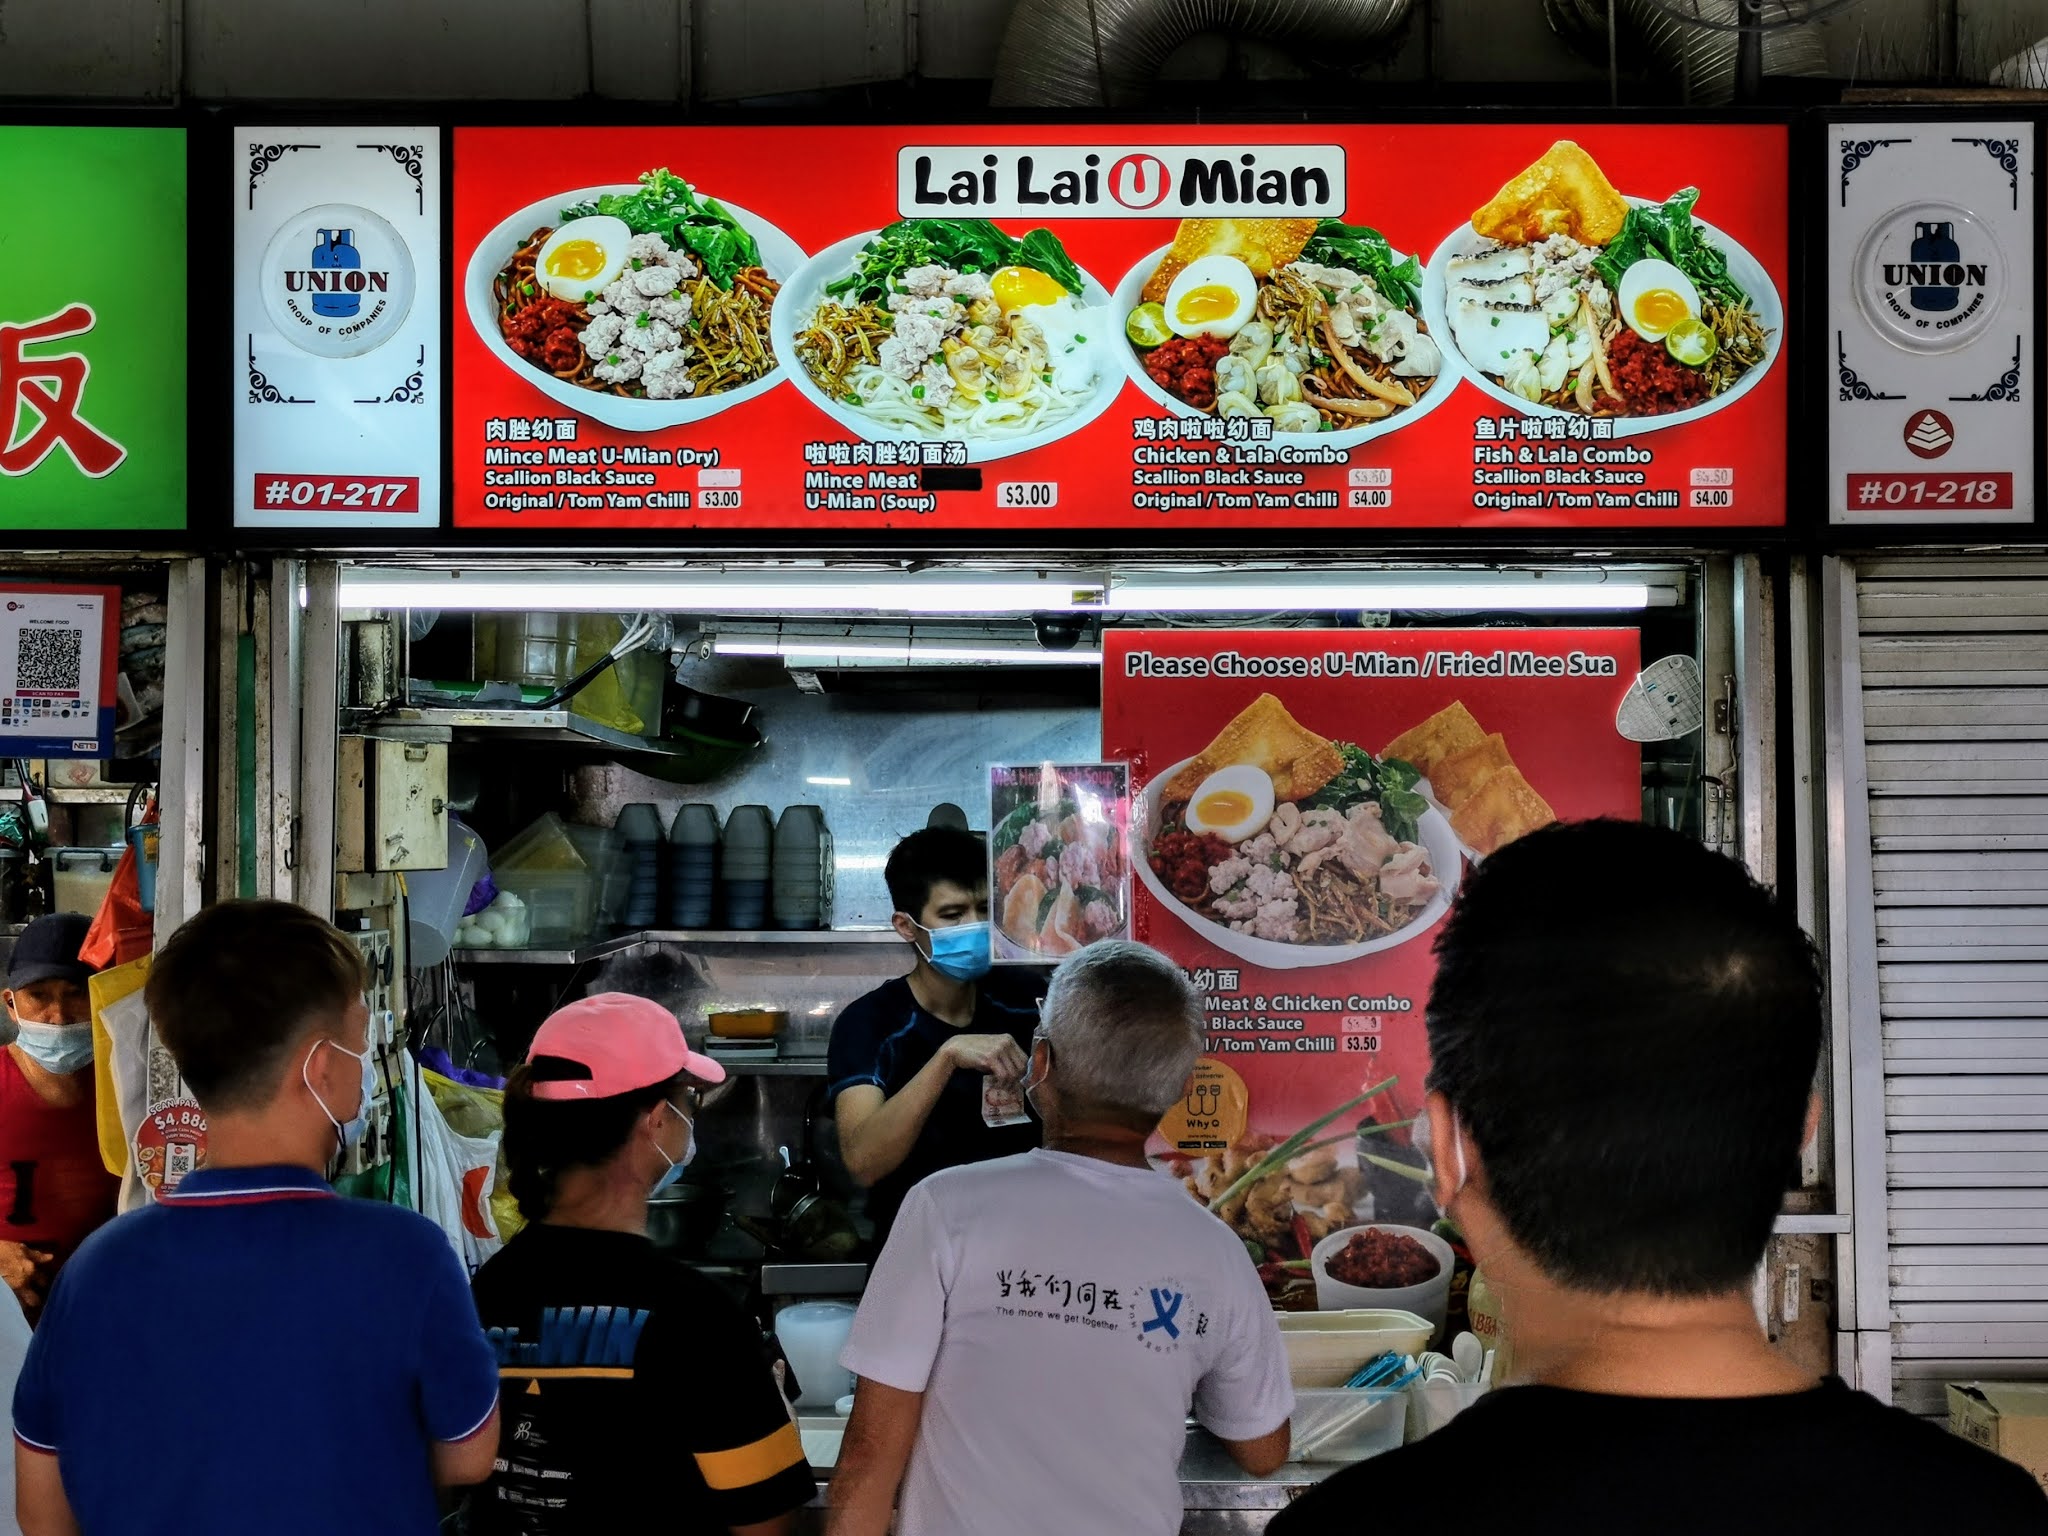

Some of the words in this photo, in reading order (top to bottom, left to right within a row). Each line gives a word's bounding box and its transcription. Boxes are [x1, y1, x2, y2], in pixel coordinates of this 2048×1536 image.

[915, 154, 998, 205] Lai
[1017, 154, 1100, 205] Lai
[1117, 157, 1162, 208] U
[1180, 153, 1330, 206] Mian
[284, 270, 389, 292] UNION
[1882, 263, 1988, 286] UNION
[287, 298, 313, 327] GROUP
[318, 325, 332, 335] OF
[338, 299, 387, 336] COMPANIES
[1886, 292, 1911, 321] GROUP
[1916, 319, 1929, 328] OF
[1936, 292, 1984, 329] COMPANIES
[485, 419, 577, 441] 肉脞幼面
[1134, 418, 1272, 440] 鸡肉啦啦幼面
[1475, 418, 1613, 440] 鱼片啦啦幼面
[486, 448, 543, 465] Mince
[549, 448, 597, 465] Meat
[602, 447, 672, 465] U-Mian
[676, 449, 719, 467] (Dry)
[805, 442, 967, 465] 啦啦肉脞幼面汤
[1134, 447, 1210, 464] Chicken
[1216, 448, 1230, 464] &
[1235, 448, 1275, 464] Lala
[1280, 447, 1348, 464] Combo
[1474, 446, 1513, 464] Fish
[1518, 448, 1533, 464] &
[1538, 447, 1578, 464] Lala
[1582, 447, 1652, 464] Combo
[485, 470, 551, 485] Scallion
[556, 470, 601, 485] Black
[605, 471, 654, 485] Sauce
[806, 472, 863, 489] Mince
[869, 472, 917, 489] Meat
[1134, 470, 1199, 485] Scallion
[1204, 469, 1250, 484] Black
[1254, 470, 1303, 484] Sauce
[1474, 469, 1540, 484] Scallion
[1545, 469, 1590, 484] Black
[1595, 470, 1644, 484] Sauce
[265, 481, 408, 507] #01-217
[485, 492, 554, 511] Original
[567, 493, 603, 508] Tom
[606, 493, 642, 508] Yam
[645, 492, 690, 508] Chilli
[705, 491, 738, 507] $3.00
[806, 492, 875, 509] U-Mian
[880, 494, 935, 511] (Soup)
[1006, 484, 1050, 505] $3.00
[1134, 492, 1202, 510] Original
[1216, 493, 1251, 507] Tom
[1255, 493, 1290, 507] Yam
[1294, 492, 1338, 507] Chilli
[1354, 490, 1386, 506] $4.00
[1474, 492, 1543, 510] Original
[1557, 492, 1592, 507] Tom
[1595, 493, 1630, 507] Yam
[1634, 492, 1678, 507] Chilli
[1696, 490, 1728, 506] $4.00
[1859, 481, 1998, 504] #01-218
[1127, 653, 1205, 677] Please
[1326, 653, 1415, 676] U-Mian
[1438, 652, 1501, 676] Fried
[1510, 653, 1564, 676] Mee
[1568, 653, 1616, 676] Sua
[1205, 996, 1249, 1011] Meat
[1254, 997, 1267, 1011] &
[1272, 995, 1342, 1011] Chicken
[1347, 995, 1411, 1011] Combo
[1212, 1016, 1253, 1030] Black
[1257, 1017, 1303, 1030] Sauce
[1222, 1038, 1255, 1051] Tom
[1259, 1038, 1291, 1051] Yam
[1295, 1036, 1335, 1051] Chilli
[1347, 1036, 1377, 1051] $3.50
[996, 1306, 1015, 1317] The
[1018, 1308, 1043, 1319] more
[1047, 1312, 1061, 1320] we
[1064, 1312, 1079, 1324] get
[1082, 1315, 1119, 1331] together
